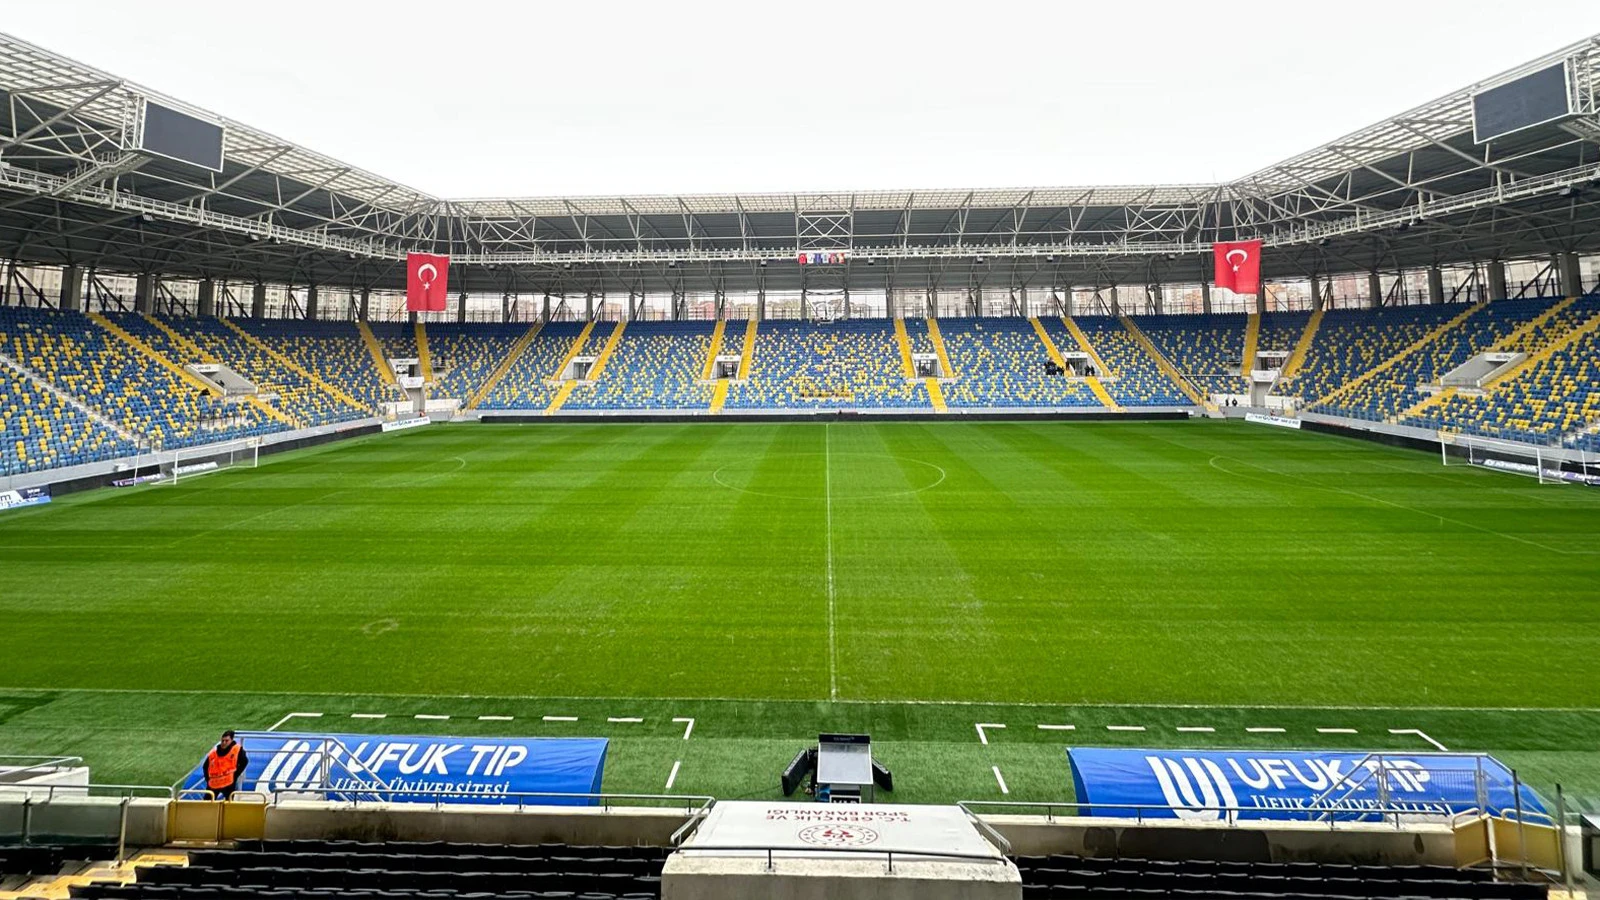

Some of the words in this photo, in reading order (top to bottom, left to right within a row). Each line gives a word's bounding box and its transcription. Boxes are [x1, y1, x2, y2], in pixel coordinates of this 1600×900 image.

[347, 742, 464, 775] UFUK
[466, 745, 528, 776] TIP
[1226, 758, 1366, 790] UFUK
[1353, 760, 1431, 792] TIP
[389, 777, 509, 798] ÜNİVERSİTESİ
